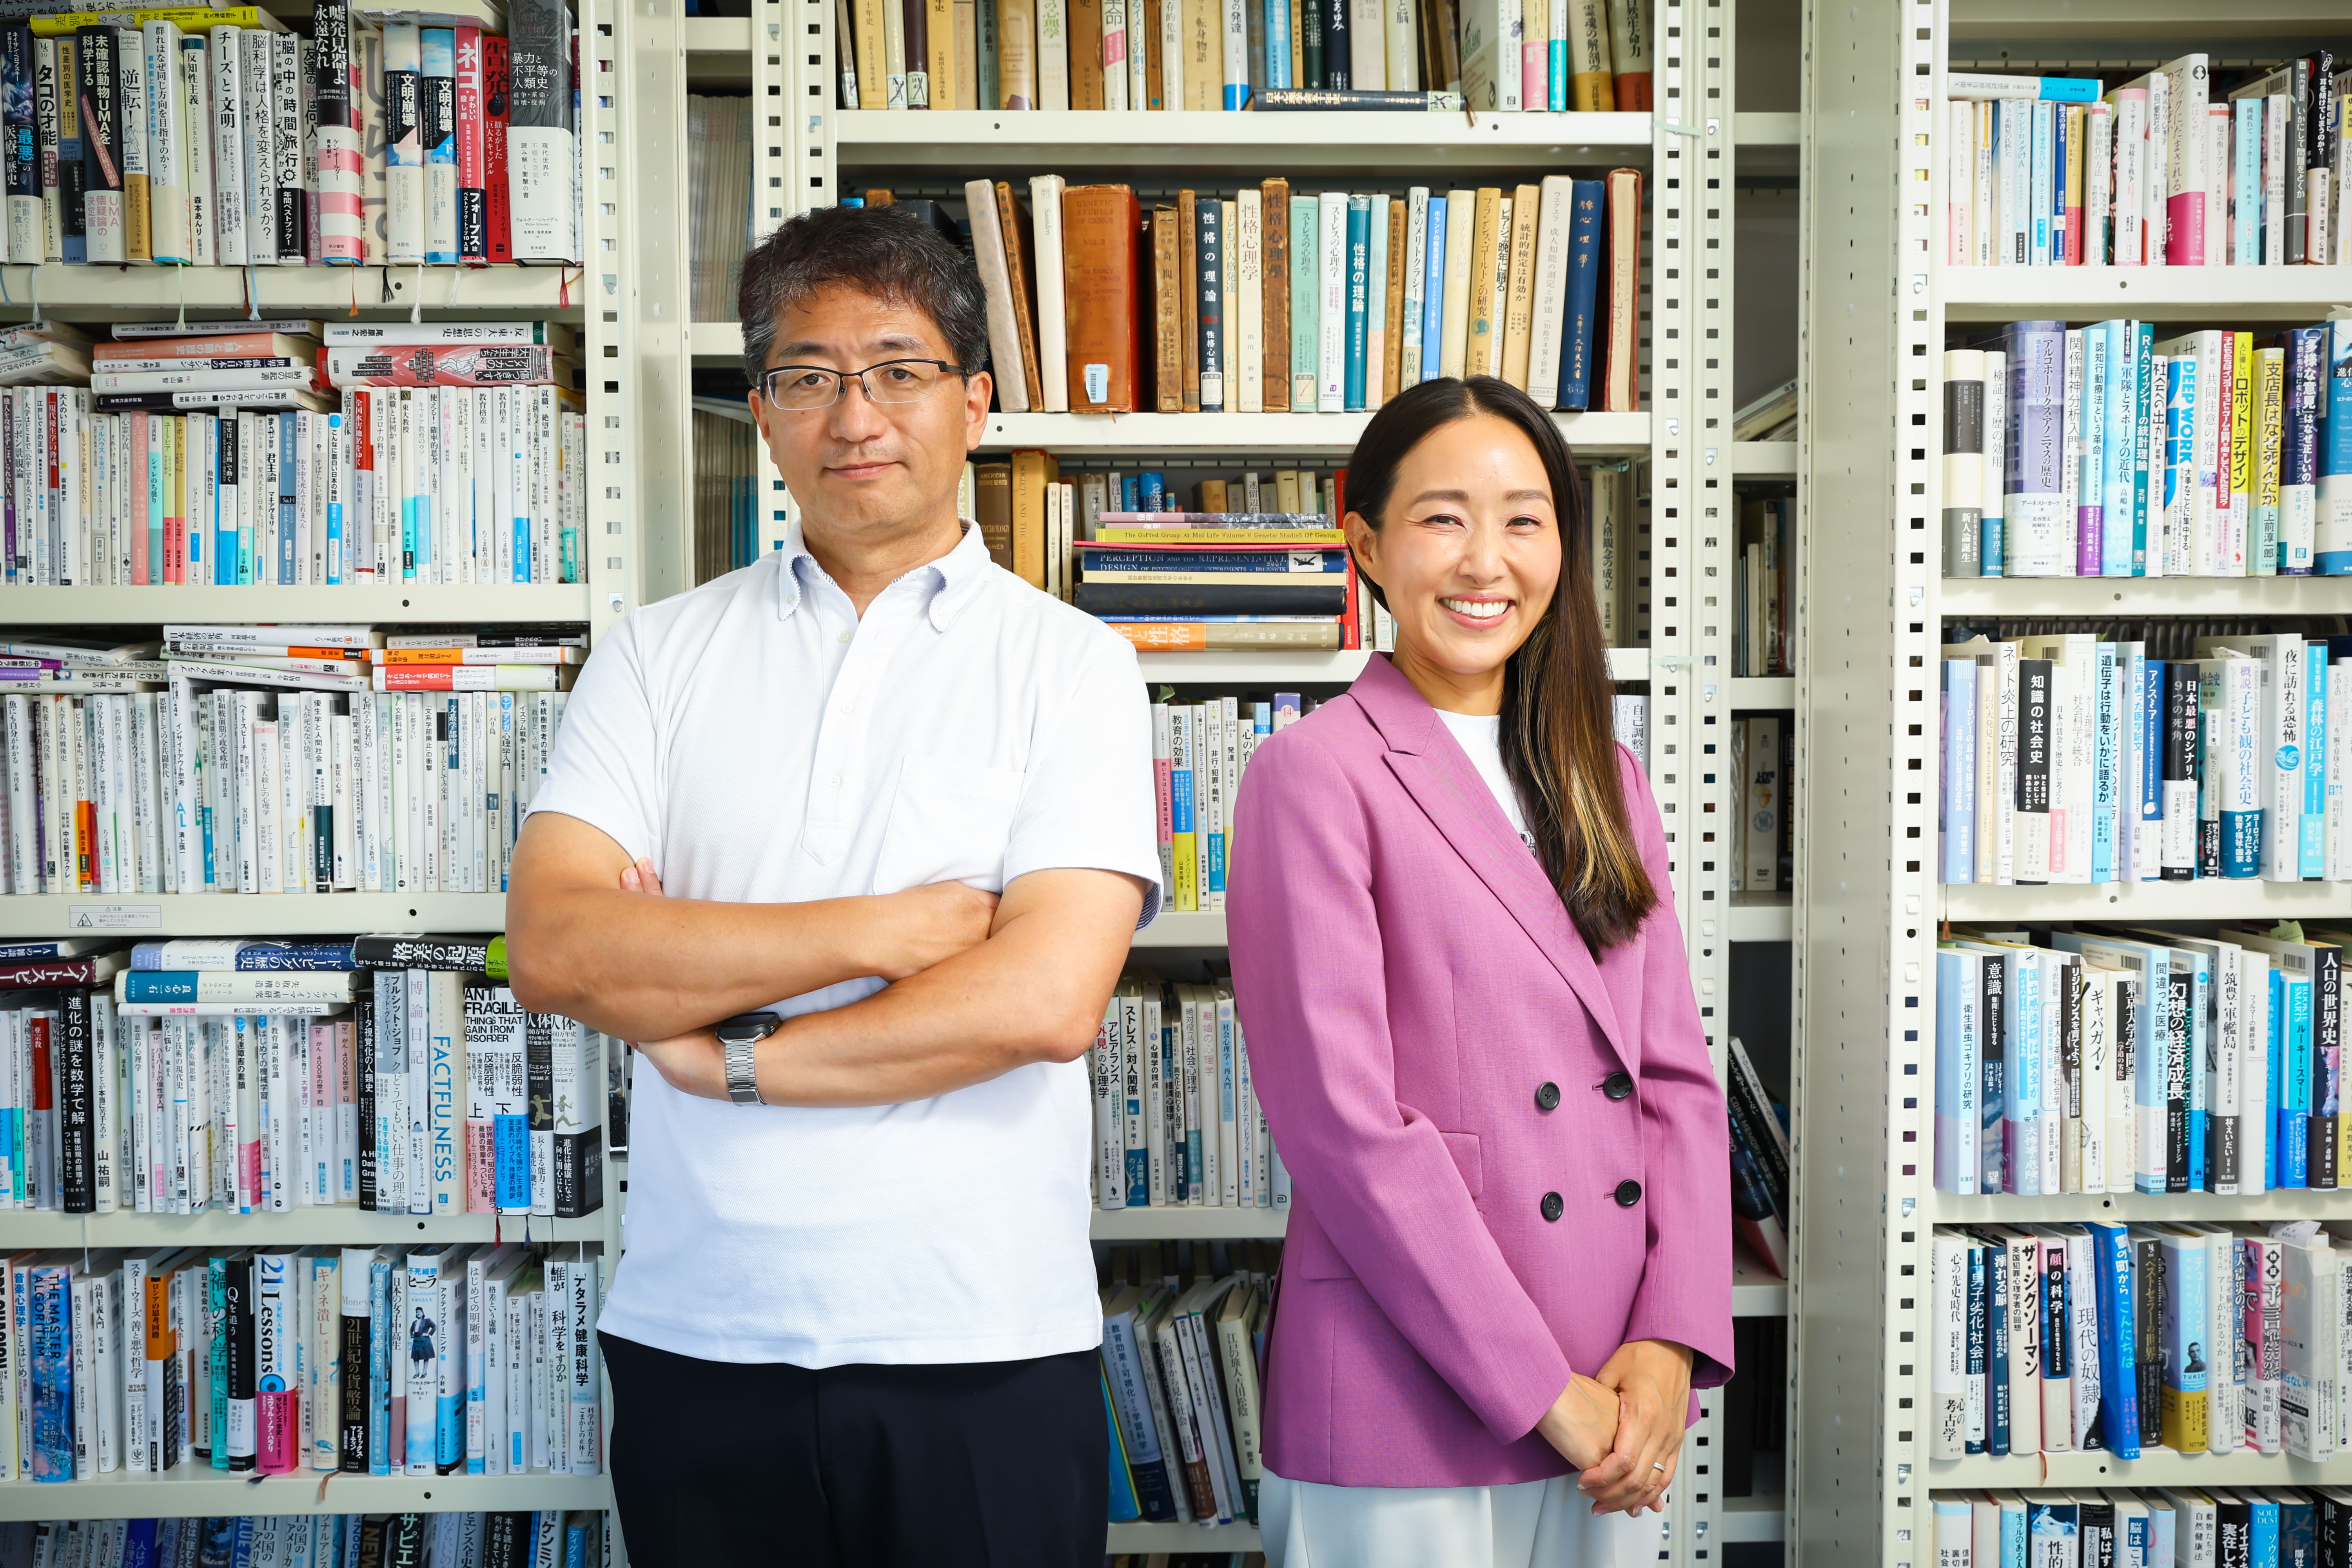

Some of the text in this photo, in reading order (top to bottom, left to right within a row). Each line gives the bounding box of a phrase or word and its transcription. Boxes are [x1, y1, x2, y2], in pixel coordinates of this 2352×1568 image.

[82, 35, 94, 86] 科学する
[315, 5, 329, 69] 永遠なれ
[330, 5, 347, 85] 嘘発見器よ
[512, 53, 541, 64] 暴力と
[512, 65, 557, 76] 不平等の
[39, 65, 57, 147] タコの才能
[62, 46, 72, 107] 性差別の医学史
[187, 53, 198, 105] 反知性主義
[219, 31, 235, 128] チーズと文明
[282, 41, 298, 167] 脳の中の時間旅行
[401, 74, 416, 126] 文明崩壊
[438, 80, 452, 132] 文明崩壊
[513, 78, 548, 89] 人類史
[4, 125, 17, 186] 医療の歴史
[17, 125, 34, 172] 「最悪」の
[2296, 106, 2305, 198] いかにして問題をとくか
[470, 193, 480, 252] フォーブス誌
[1203, 212, 1216, 302] 性格の理論
[1242, 204, 1258, 280] 性格心理学
[1301, 212, 1310, 276] ストレスの心理学
[1330, 206, 1340, 276] ストレスの心理学
[1412, 195, 1424, 298] 日本のメリトクラシー
[1478, 198, 1492, 316] フランシス・ゴールトンの研究
[1496, 209, 1510, 291] ピアジェ晩年に語る
[1353, 243, 1365, 312] 性格の理論
[1515, 223, 1531, 301] 統計的検定は有効か
[487, 358, 529, 368] アメリカの
[2067, 337, 2081, 448] 関係精神分析入門
[1992, 370, 2004, 467] 検証・学歴の効用
[2093, 342, 2103, 455] 認知行動療法という革命
[2119, 367, 2132, 483] 軍隊とスポーツの近代
[2179, 361, 2194, 465] DEEP WORK
[267, 454, 276, 482] 君主論
[2233, 379, 2249, 489] ロボットのデザイン
[2262, 362, 2281, 506] 支店長はなぜ死んだか
[981, 525, 1009, 533] SYCHOLOGY
[1100, 554, 1163, 562] PERCEPTION
[1198, 554, 1287, 563] REPRESENTATIVE
[1602, 515, 1613, 590] 人格観念の成立
[2000, 646, 2015, 766] ネット炎上の研究
[2030, 675, 2044, 764] 知識の社会史
[2098, 655, 2112, 802] 遺伝子は行動をいかに語るか
[2134, 655, 2143, 751] 本当にあった医学論文
[2147, 671, 2158, 719] アノスミア
[2283, 650, 2297, 742] 夜に訪れる恐怖
[314, 699, 323, 762] 優生学と人間社会
[449, 705, 458, 756] 文系学部解体
[502, 733, 510, 770] 心理学入門
[1172, 715, 1184, 768] 教育の効果
[1227, 747, 1235, 762] 発達
[2239, 691, 2252, 805] 子ども観の社会史
[2309, 699, 2323, 776] 森林の江戸学
[1757, 771, 1775, 781] LIVE
[392, 943, 485, 964] 格差の起源
[1987, 963, 2002, 995] 意識
[391, 975, 401, 1055] ブルシット・ジョブ
[410, 981, 423, 1065] 博論日記
[465, 1025, 488, 1034] GAIN
[498, 1016, 523, 1025] THAT
[2071, 967, 2080, 1065] リジリアンスを育てよう
[2155, 963, 2167, 1041] 間違った医療
[2223, 973, 2238, 1049] 筑豊・軍艦島
[2321, 952, 2338, 1044] 人口の世界史
[364, 1002, 374, 1093] データ視覚化の人類史
[484, 1053, 494, 1097] 反脆弱性
[512, 1053, 523, 1097] 反脆弱性
[1107, 1022, 1120, 1083] アピアランス
[1125, 1006, 1138, 1095] ストレスと対人関係
[1186, 1047, 1196, 1094] 社会心理学
[2168, 982, 2187, 1100] 幻想の経済成長
[468, 1103, 485, 1118] 上
[496, 1103, 512, 1114] 下
[563, 1139, 572, 1202] 進化は健康になど
[15, 1273, 25, 1327] 音楽心理学
[34, 1275, 45, 1356] ALGORITHM
[49, 1274, 61, 1358] THE MASTER
[211, 1269, 226, 1362] 禍いの科学
[262, 1258, 284, 1372] 21 Lessons
[342, 1296, 368, 1308] Money
[408, 1276, 436, 1288] ヒーラ
[2022, 1244, 2038, 1377] ザ・ジグソーマン
[2049, 1252, 2063, 1314] 顔の科学
[2114, 1236, 2133, 1368] 雪の町から こんにちは
[2262, 1281, 2281, 1330] 予言
[131, 1321, 142, 1378] 善と悪の哲学
[2077, 1308, 2100, 1404] 現代の奴隷
